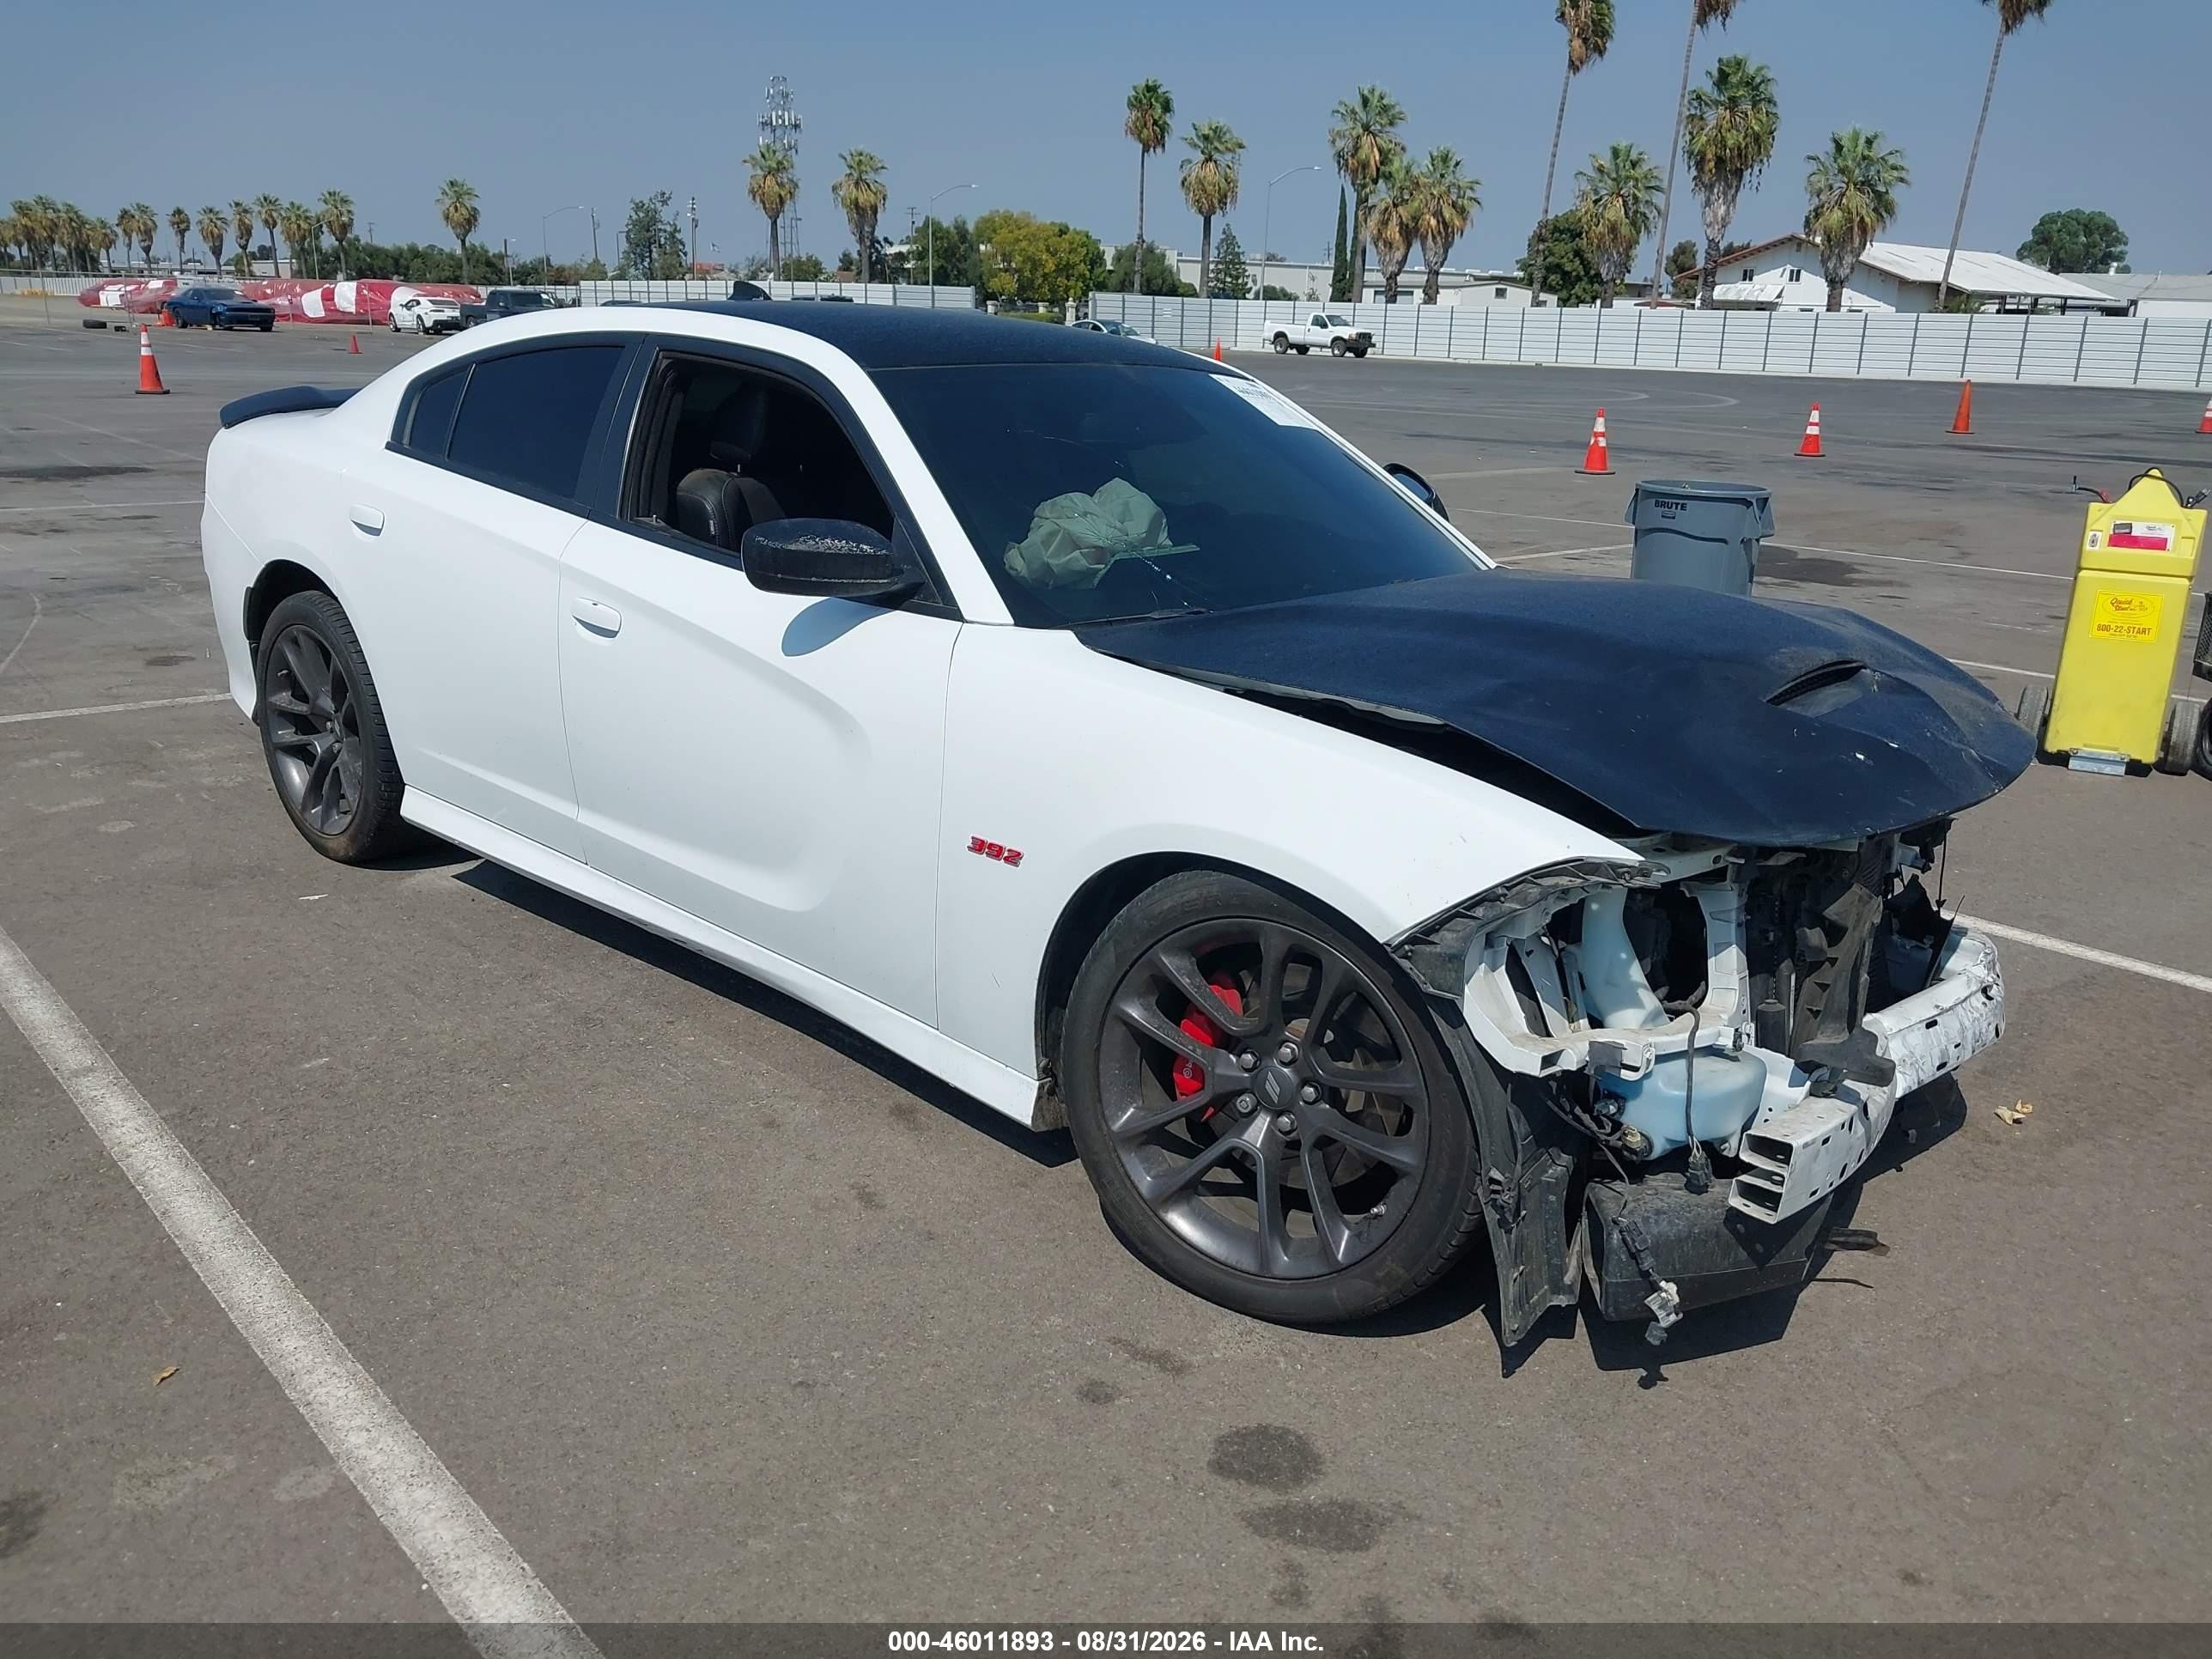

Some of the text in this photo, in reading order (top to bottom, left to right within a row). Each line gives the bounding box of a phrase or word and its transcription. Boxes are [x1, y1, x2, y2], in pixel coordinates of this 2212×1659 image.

[1654, 499, 1687, 511] BRUTE
[2096, 623, 2153, 635] 800-22-START
[967, 836, 1024, 868] 392
